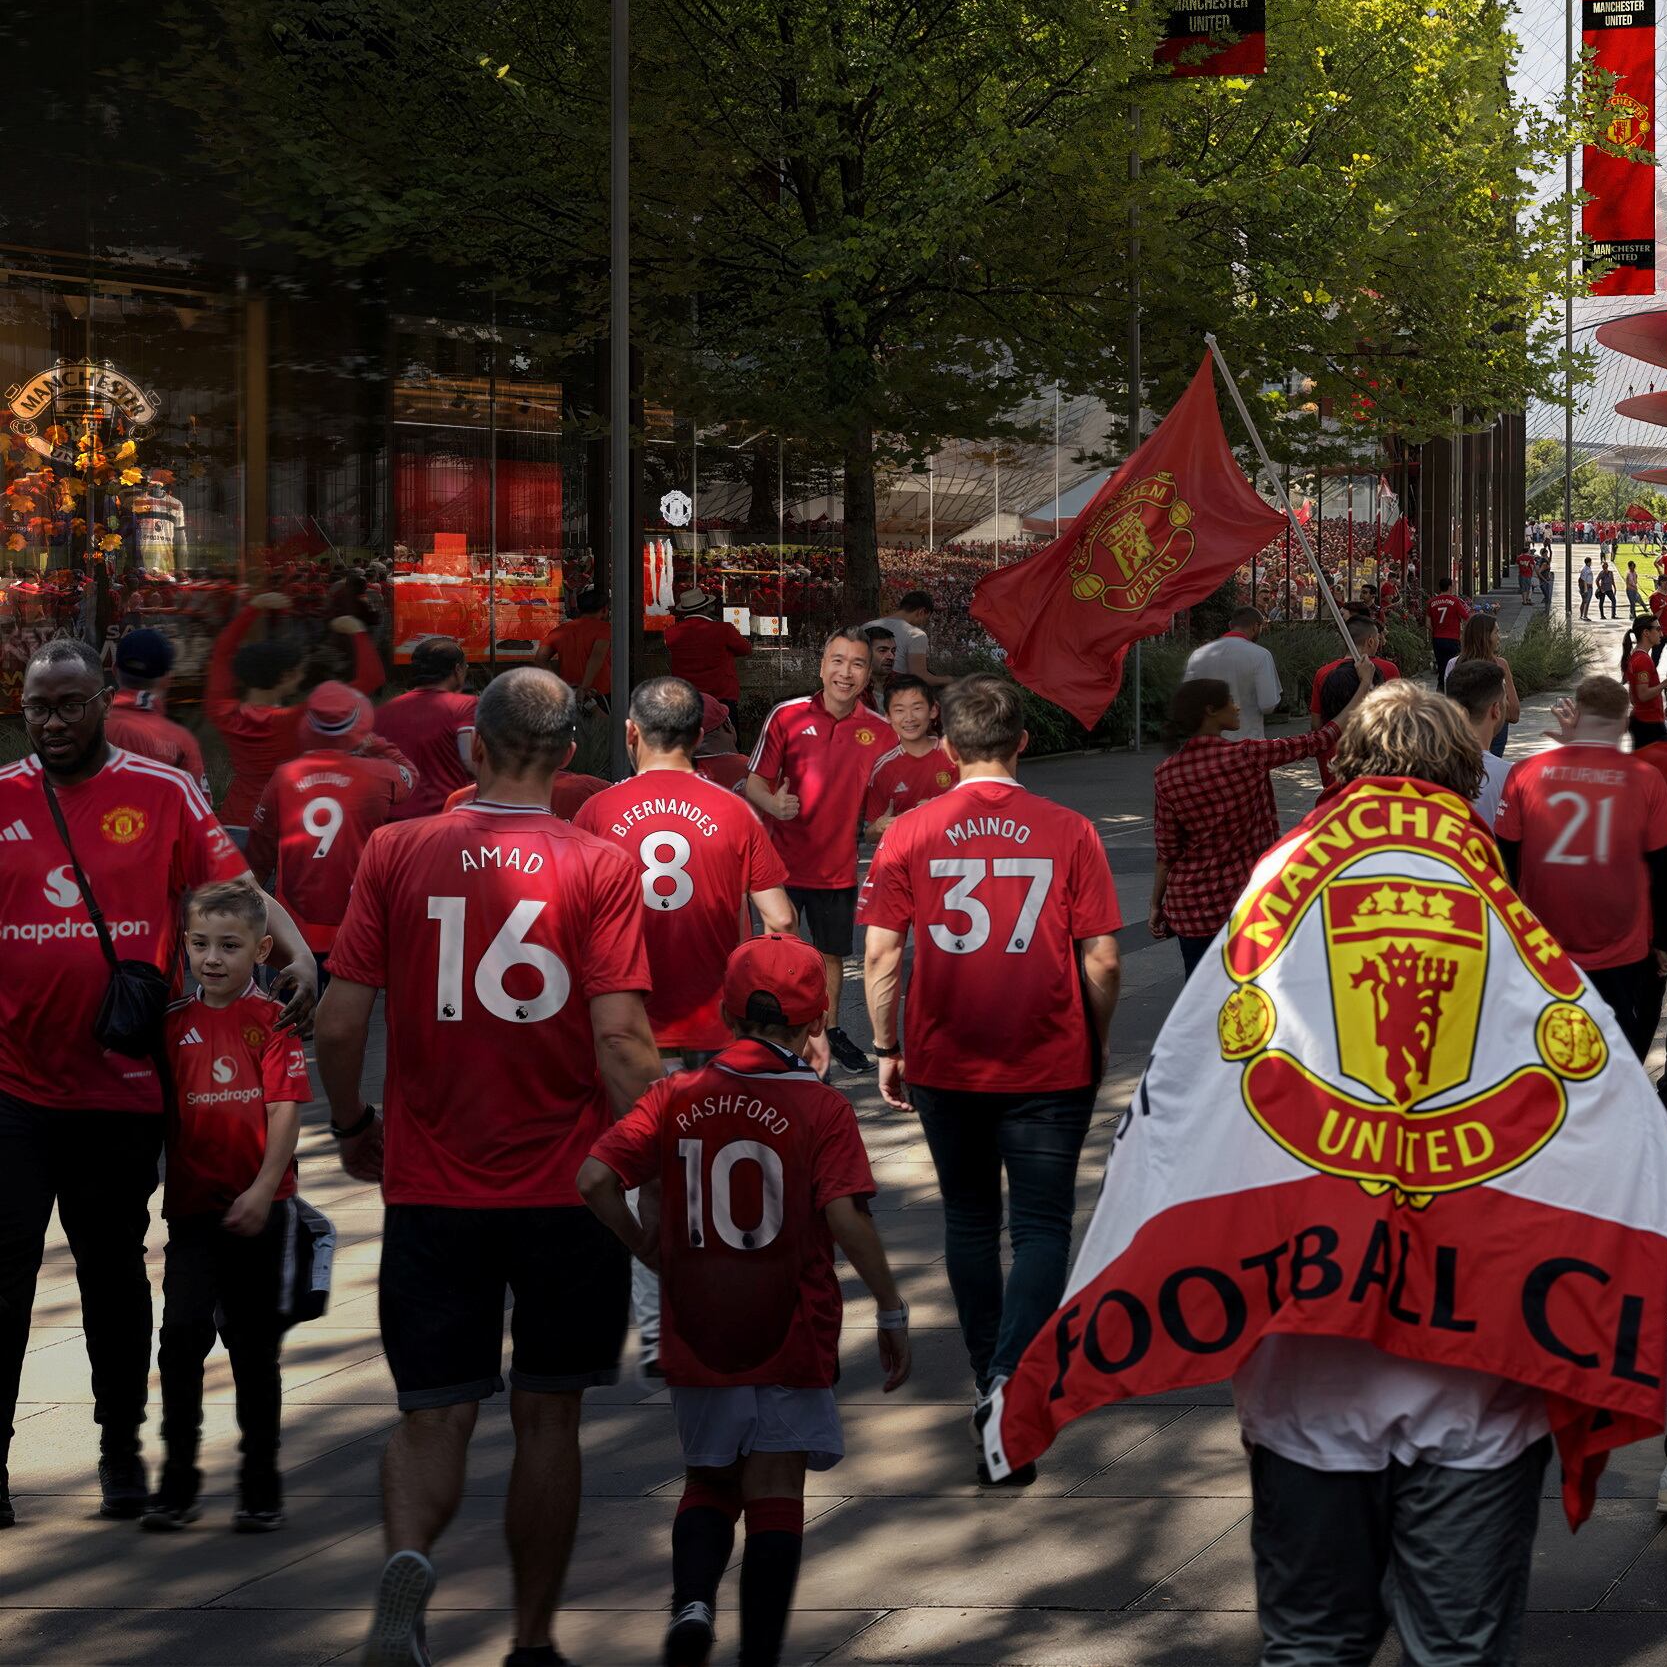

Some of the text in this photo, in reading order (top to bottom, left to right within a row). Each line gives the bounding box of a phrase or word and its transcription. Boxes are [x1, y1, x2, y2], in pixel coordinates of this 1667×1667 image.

[1592, 0, 1645, 14] MANCHESTER
[1604, 14, 1633, 26] UNITED
[1437, 606, 1448, 624] 7
[302, 795, 344, 859] 9
[610, 797, 719, 838] B.FERNANDES
[945, 817, 1031, 847] MAINOO
[1543, 790, 1613, 866] 21
[460, 845, 546, 874] AMAD
[639, 830, 694, 912] 8
[928, 857, 1054, 954] 37
[427, 896, 571, 1024] 16
[675, 1094, 790, 1135] RASHFORD
[1317, 1108, 1495, 1174] UNITED
[678, 1138, 784, 1250] 10
